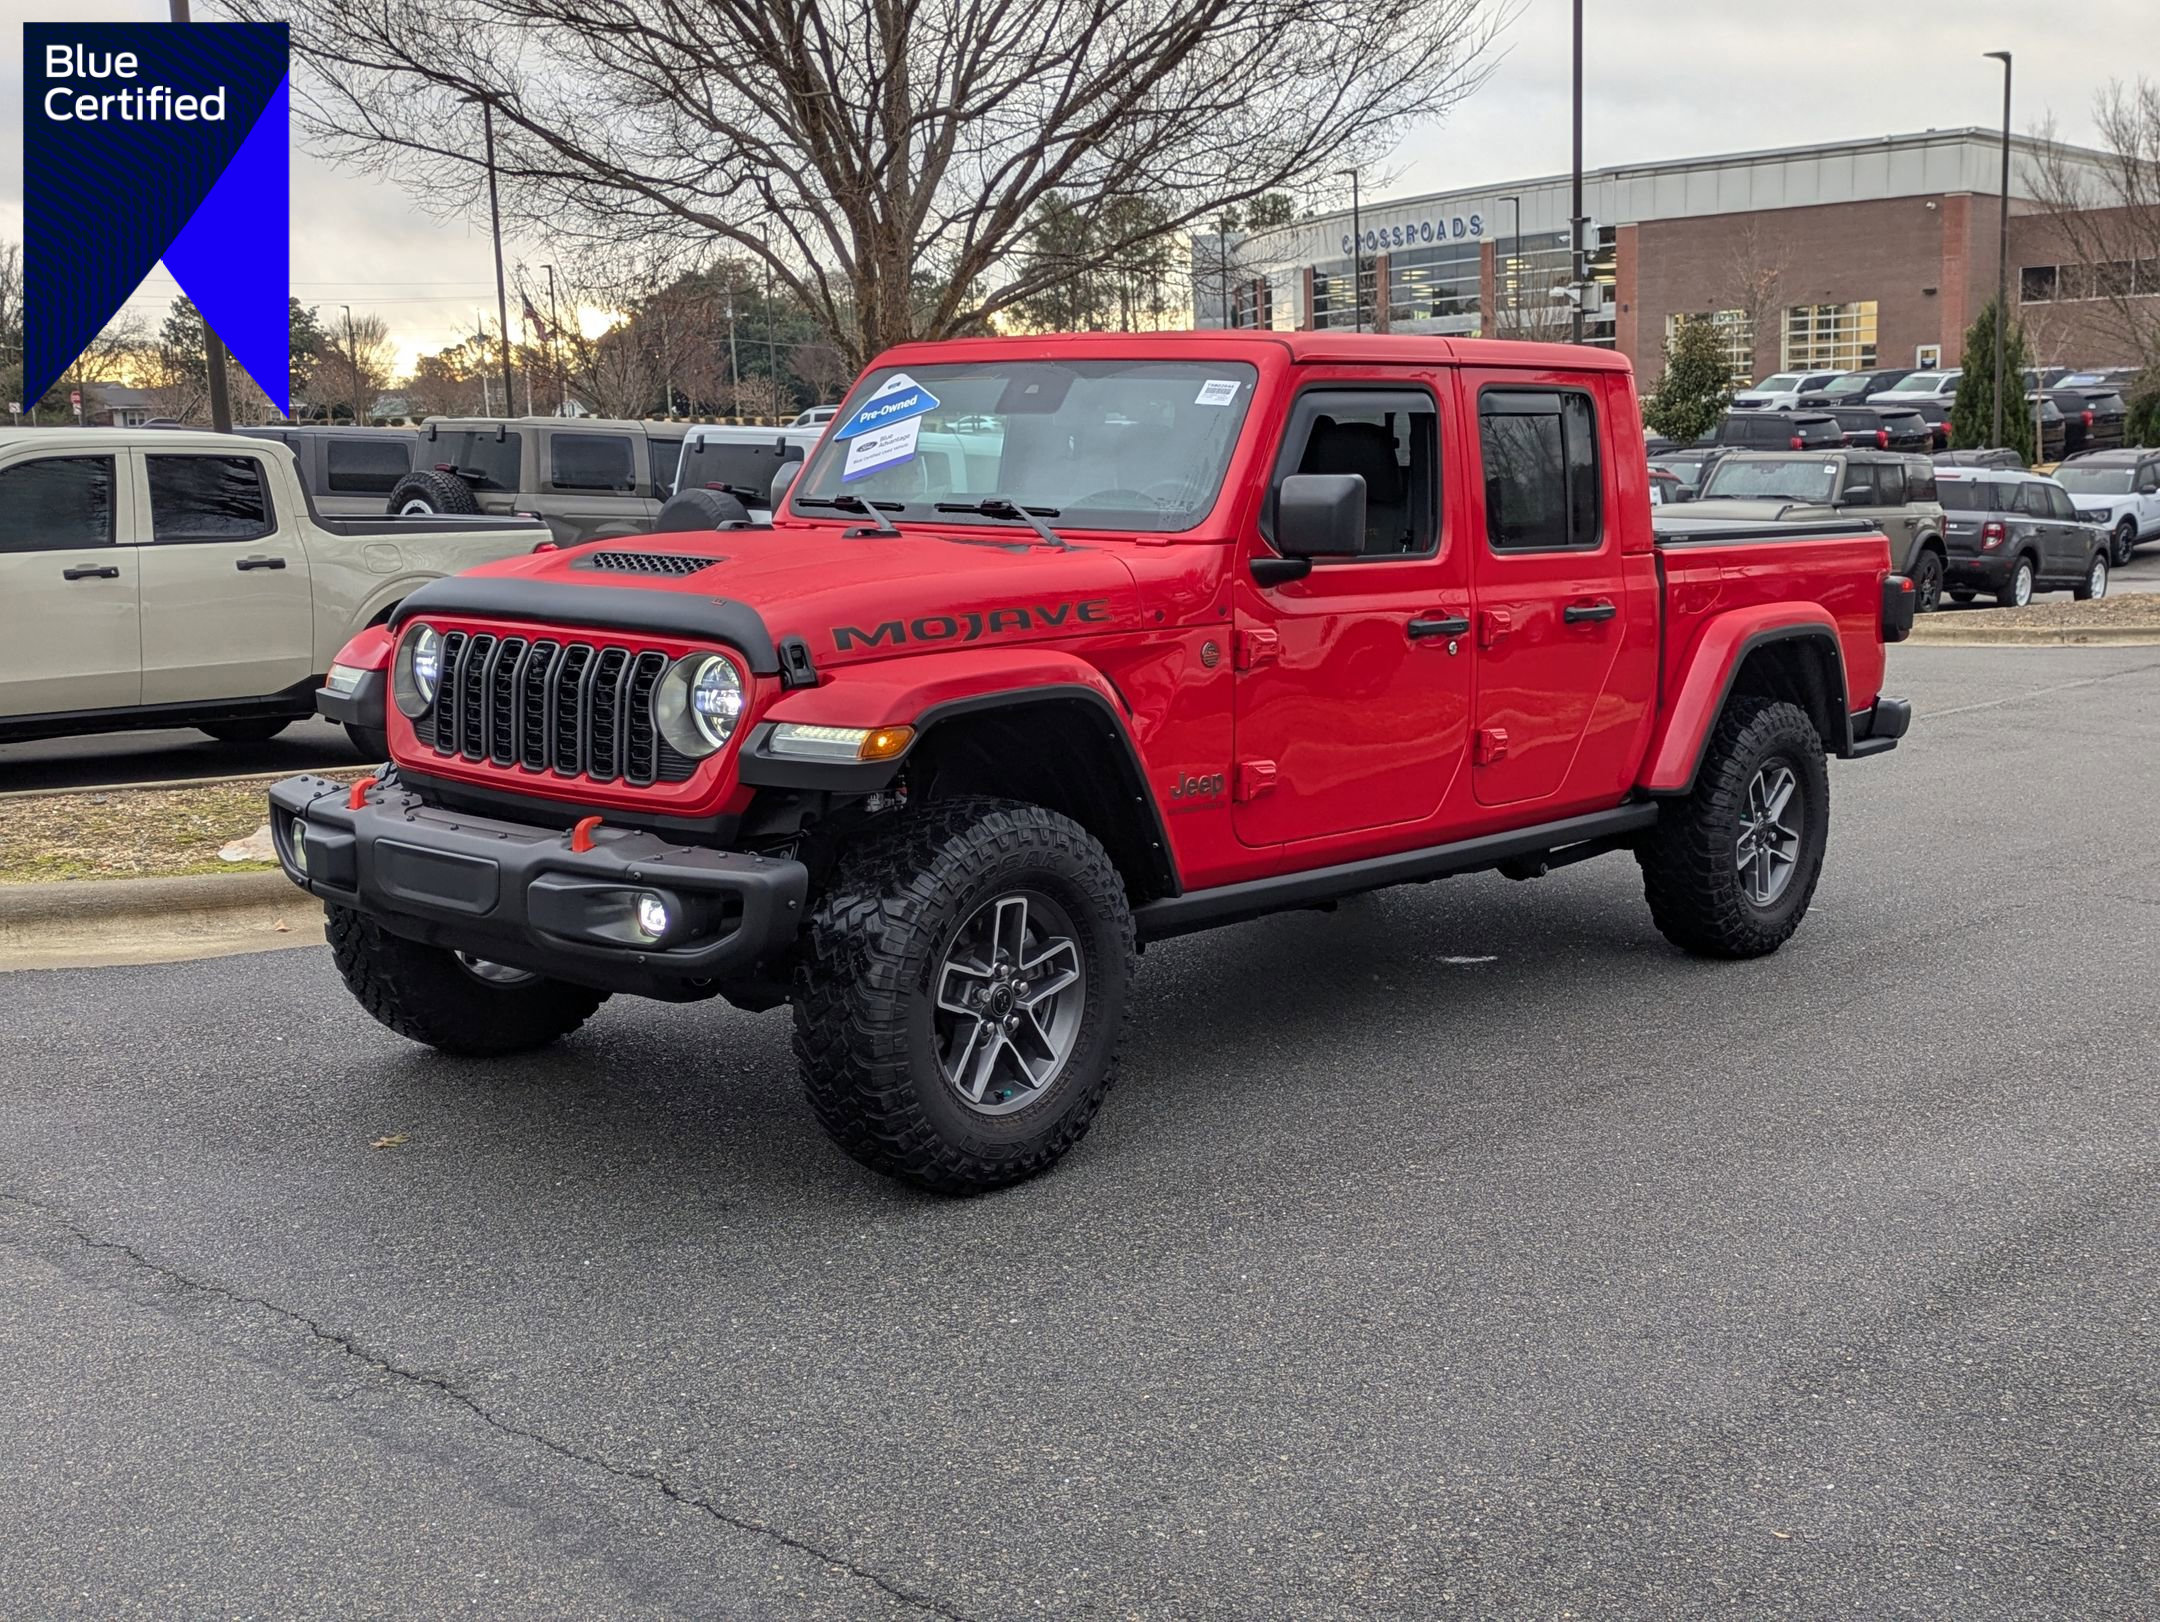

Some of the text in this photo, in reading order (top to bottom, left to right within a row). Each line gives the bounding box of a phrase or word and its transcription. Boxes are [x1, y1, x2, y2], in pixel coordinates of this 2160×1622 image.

[860, 394, 919, 423] Pre-Owned
[830, 599, 1111, 651] MOJAVE
[1169, 771, 1224, 800] Jeep
